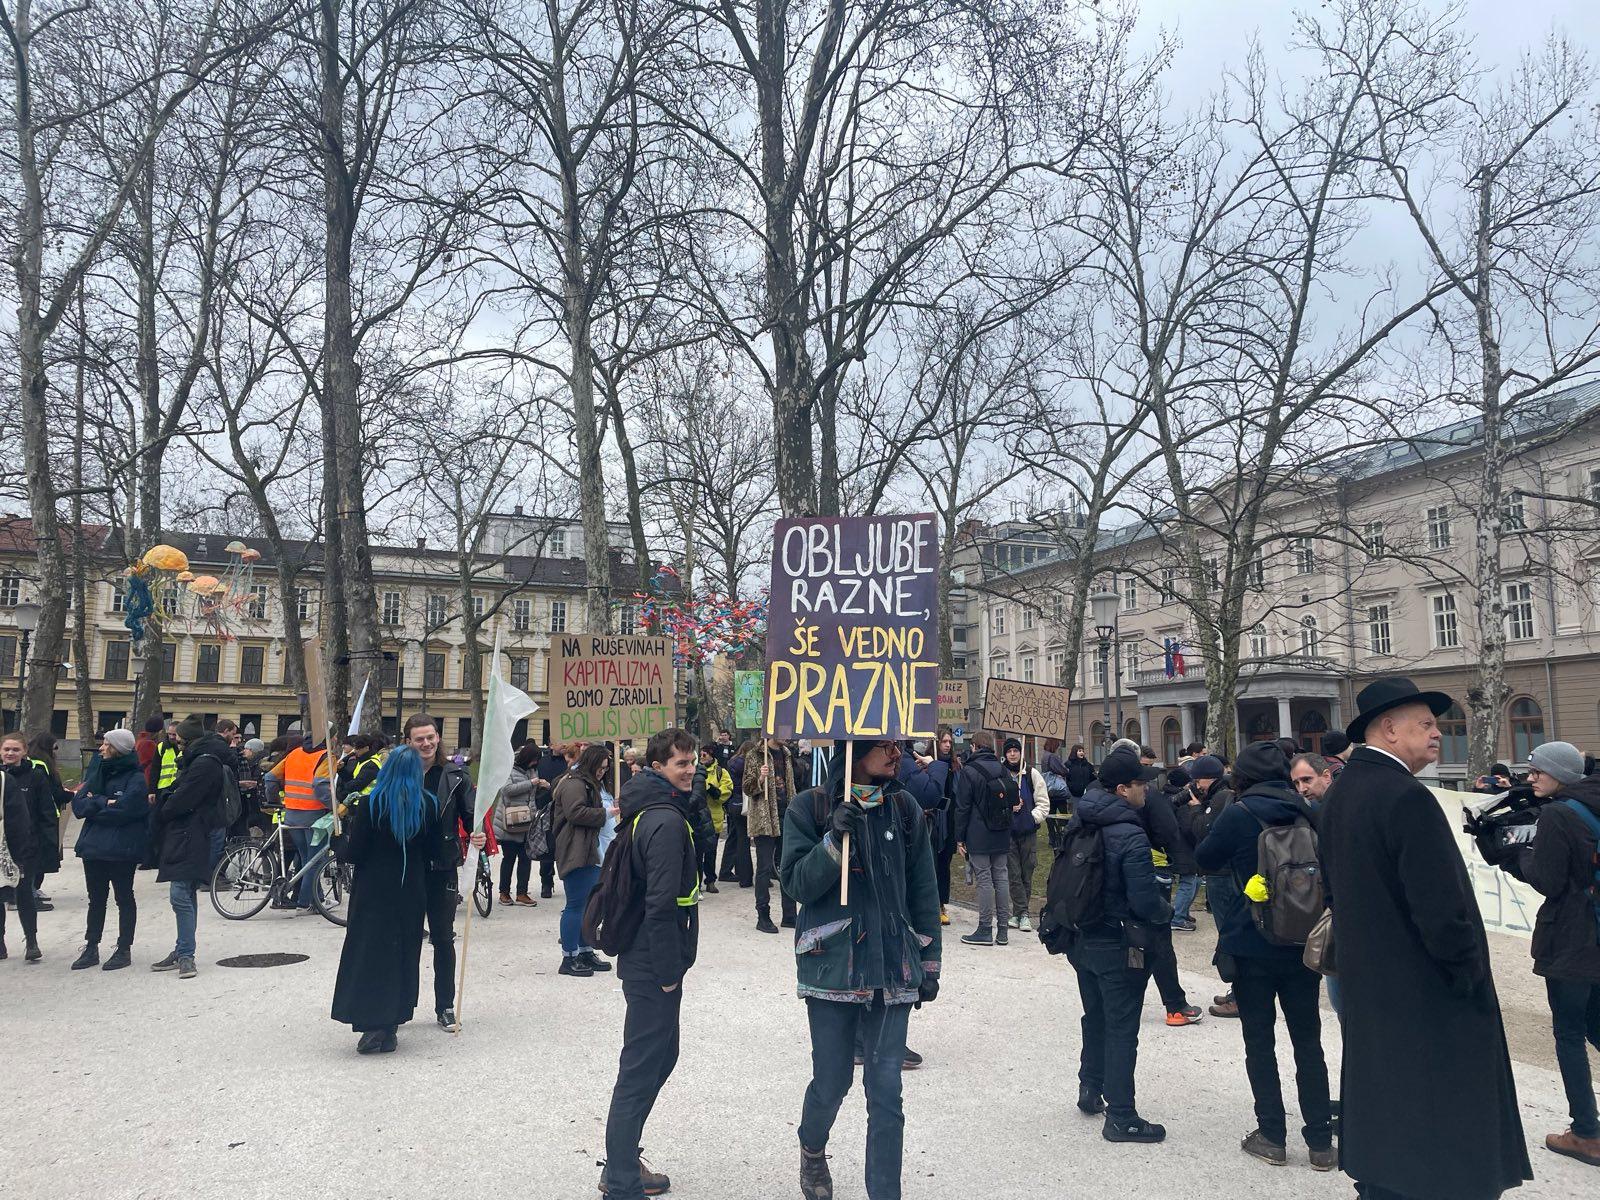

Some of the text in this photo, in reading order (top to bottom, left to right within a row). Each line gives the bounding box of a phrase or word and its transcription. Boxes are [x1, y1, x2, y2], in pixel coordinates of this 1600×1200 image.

[782, 520, 934, 577] OBLJUBE
[791, 575, 931, 621] RAZNE,
[562, 637, 665, 657] NA RUŠEVINAH
[789, 617, 924, 659] ŠE VEDNO
[564, 660, 663, 686] KAPITALIZMA
[567, 688, 662, 708] BOMO ZGRADILI
[767, 661, 939, 737] PRAZNE
[991, 692, 1006, 704] NE
[994, 683, 1065, 702] NARAVA NAS
[560, 706, 672, 740] BOLJŠI SVET
[988, 711, 1059, 735] NARAVO
